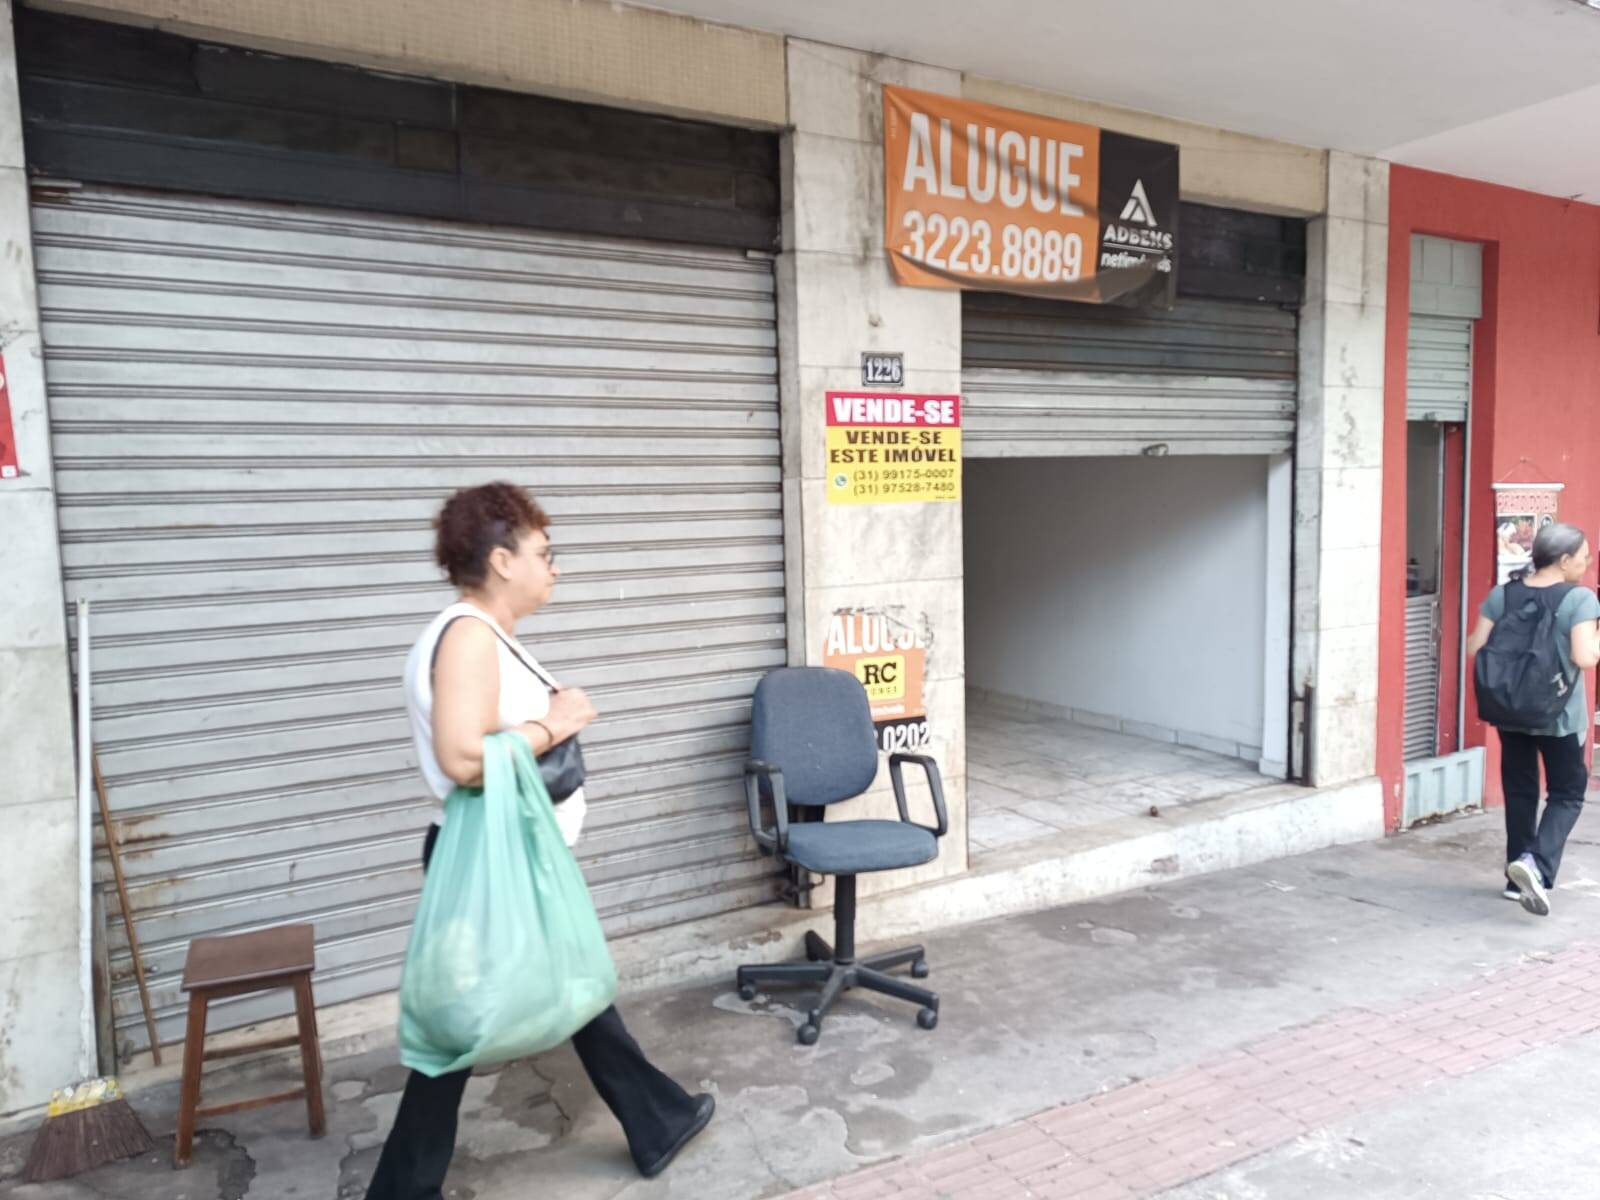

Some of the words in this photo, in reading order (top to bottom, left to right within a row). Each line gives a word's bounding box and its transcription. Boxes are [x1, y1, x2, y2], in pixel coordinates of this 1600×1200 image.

[903, 112, 1084, 217] ALUGUE
[902, 209, 1082, 282] 3223.8889
[866, 358, 900, 381] 1226
[832, 397, 955, 424] VENDE-SE
[846, 431, 942, 444] VENDE-SE
[830, 449, 878, 463] ESTE
[885, 446, 957, 463] IMÓVEL
[853, 470, 879, 482] (31)
[853, 483, 879, 496] (31)
[864, 662, 897, 685] RC
[883, 722, 929, 751] 0202
